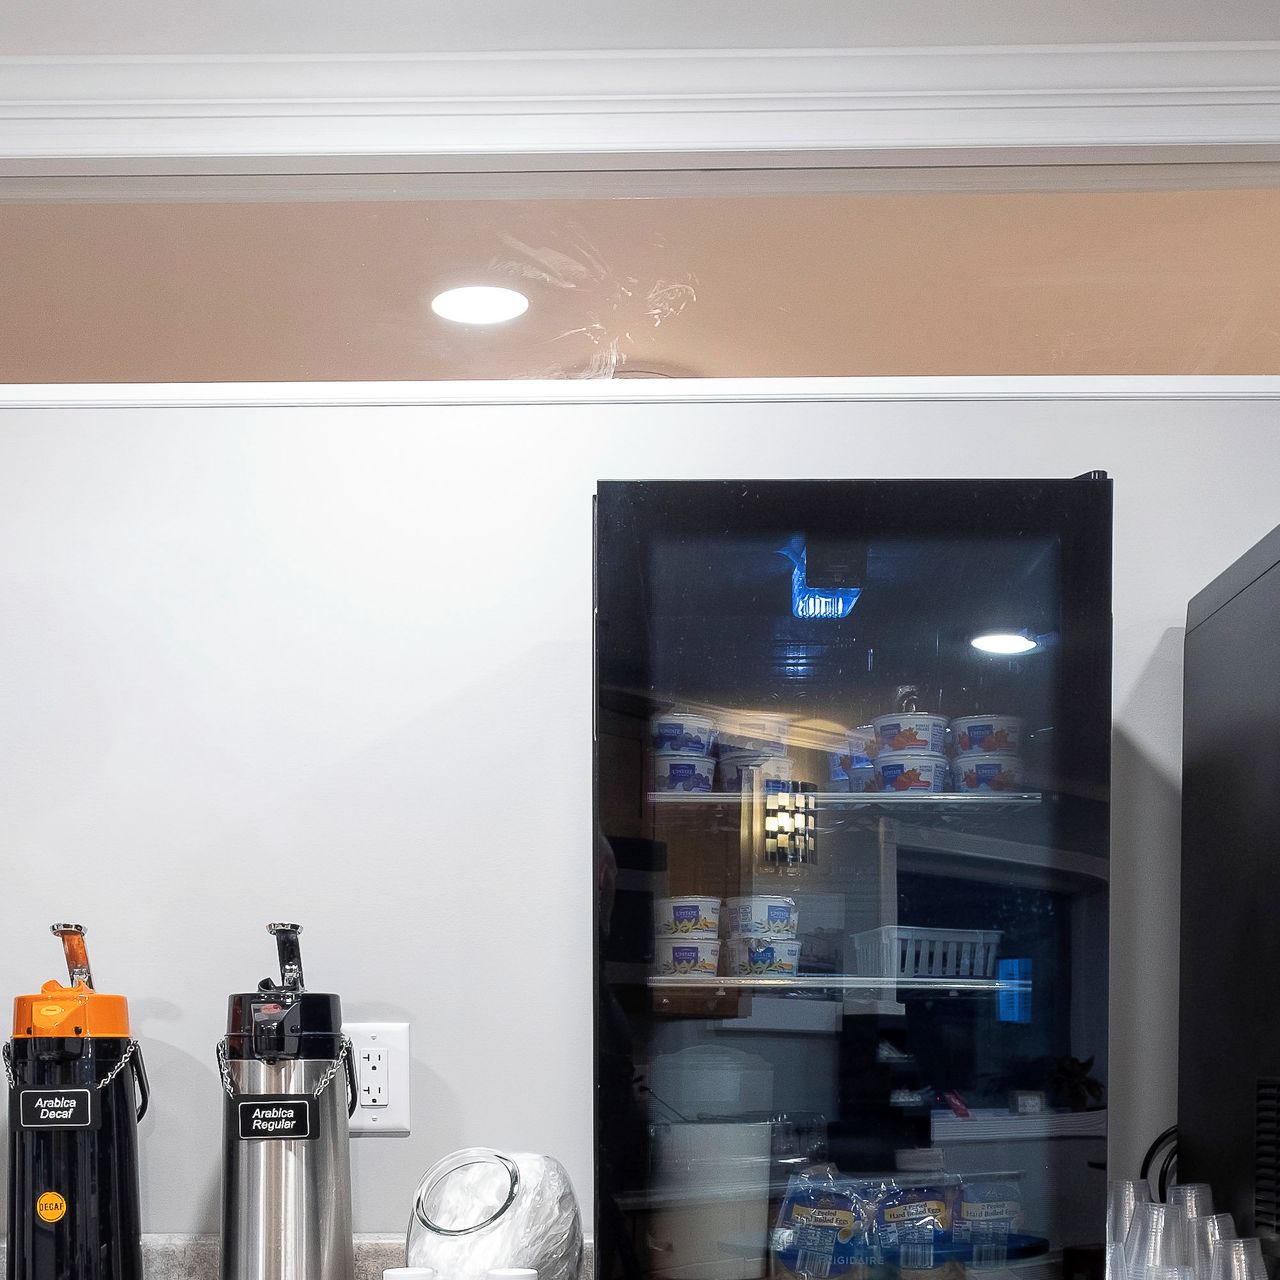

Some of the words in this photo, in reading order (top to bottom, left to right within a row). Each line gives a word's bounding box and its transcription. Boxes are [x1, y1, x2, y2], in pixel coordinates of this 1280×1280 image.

[35, 1097, 77, 1108] Arabica
[40, 1108, 74, 1119] Decaf
[252, 1108, 294, 1119] Arabica
[252, 1119, 296, 1132] Regular
[40, 1203, 64, 1211] DECAF
[889, 1211, 907, 1219] Hard
